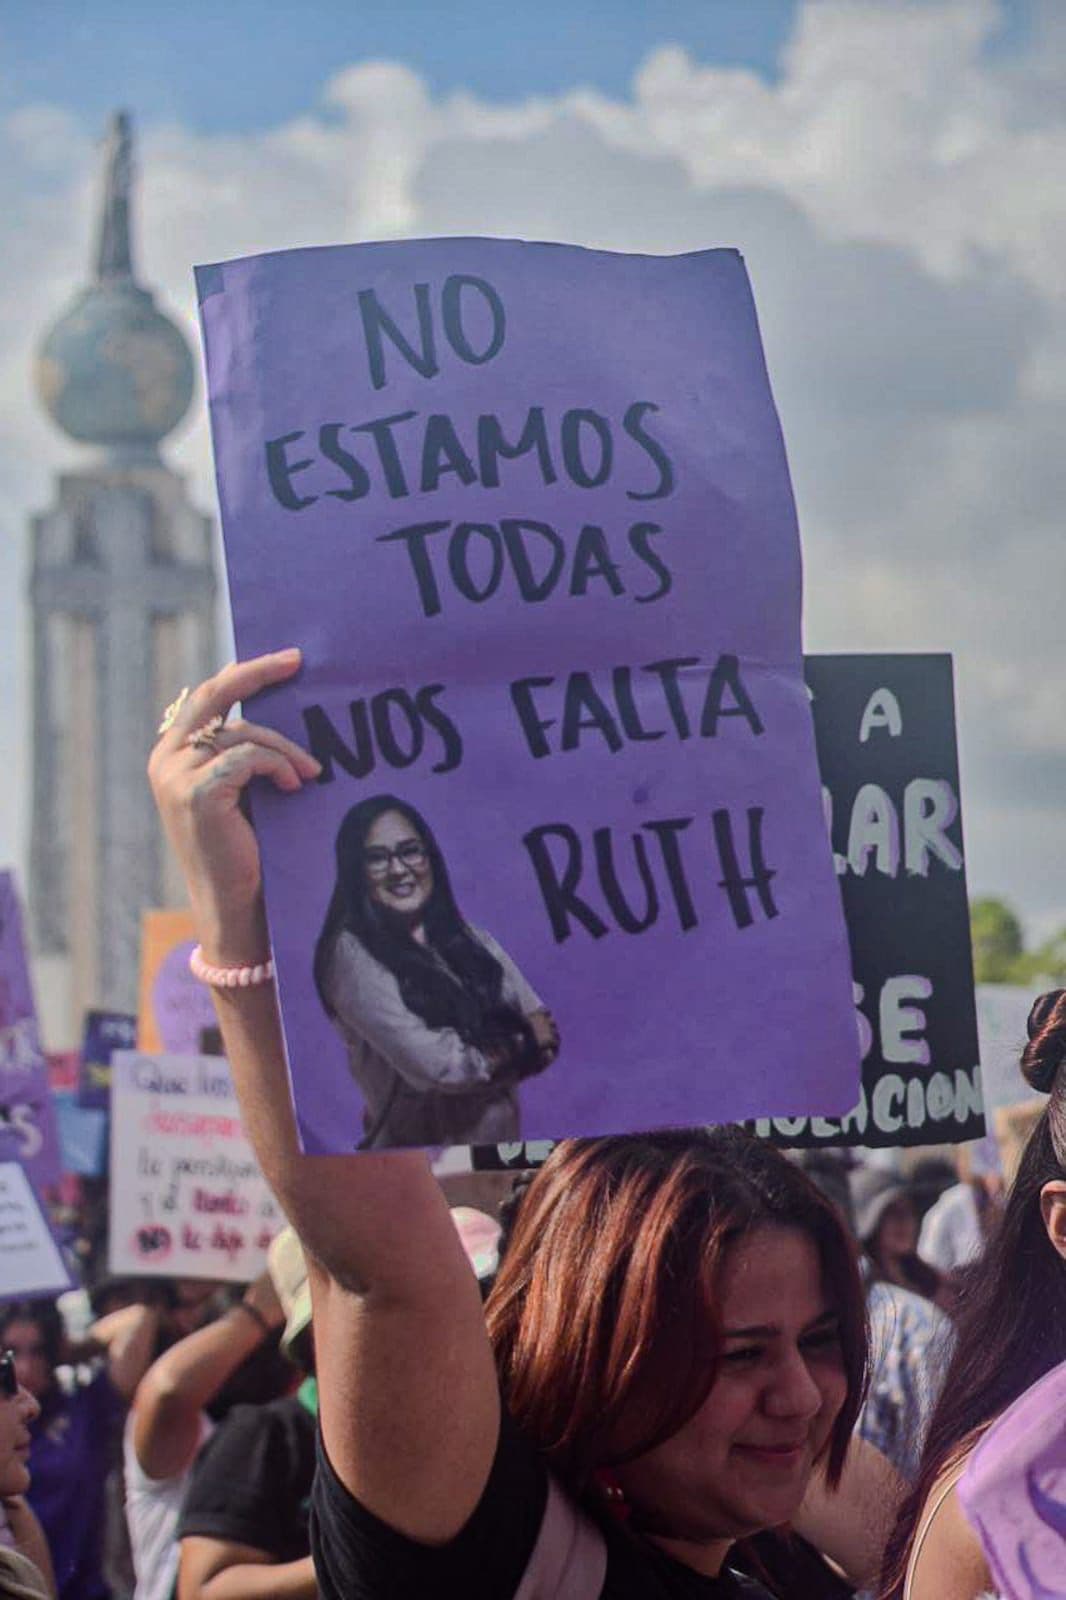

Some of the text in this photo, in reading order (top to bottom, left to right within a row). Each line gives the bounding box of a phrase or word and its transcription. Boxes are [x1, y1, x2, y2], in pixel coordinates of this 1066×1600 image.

[356, 274, 507, 391] NO
[264, 400, 675, 511] ESTAMOS
[375, 518, 673, 618] TODAS
[302, 654, 765, 784] NOS FALTA
[859, 687, 902, 742] A
[522, 806, 780, 944] RUTH
